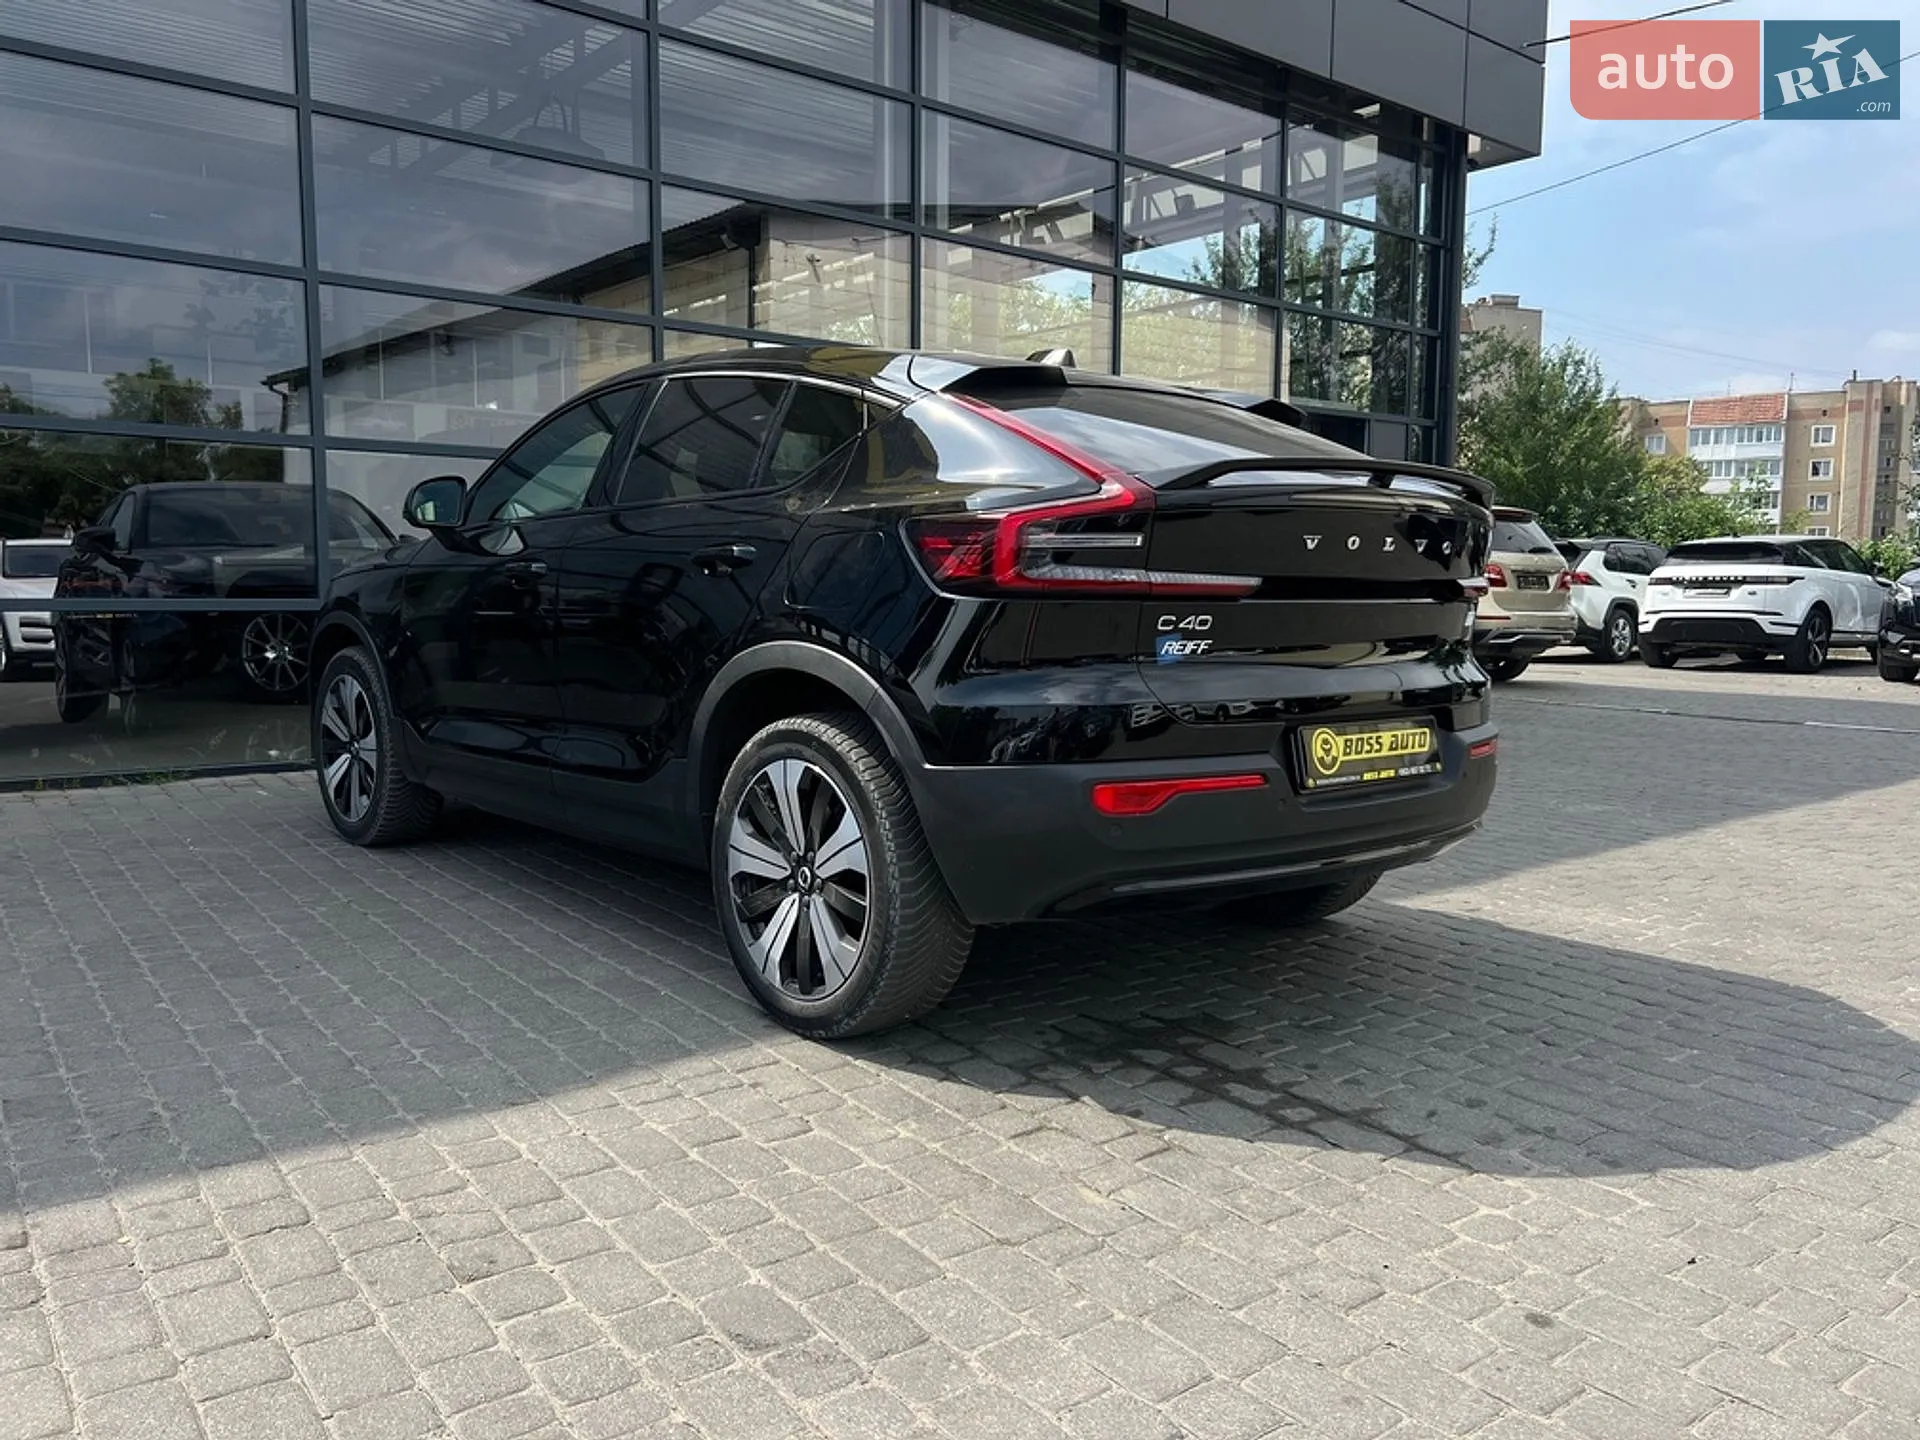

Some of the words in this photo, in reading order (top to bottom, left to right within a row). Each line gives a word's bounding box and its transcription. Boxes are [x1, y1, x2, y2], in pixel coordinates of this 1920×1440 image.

[1303, 535, 1452, 554] VOLVO
[1160, 640, 1213, 655] REIFF
[1342, 736, 1384, 757] BOSS
